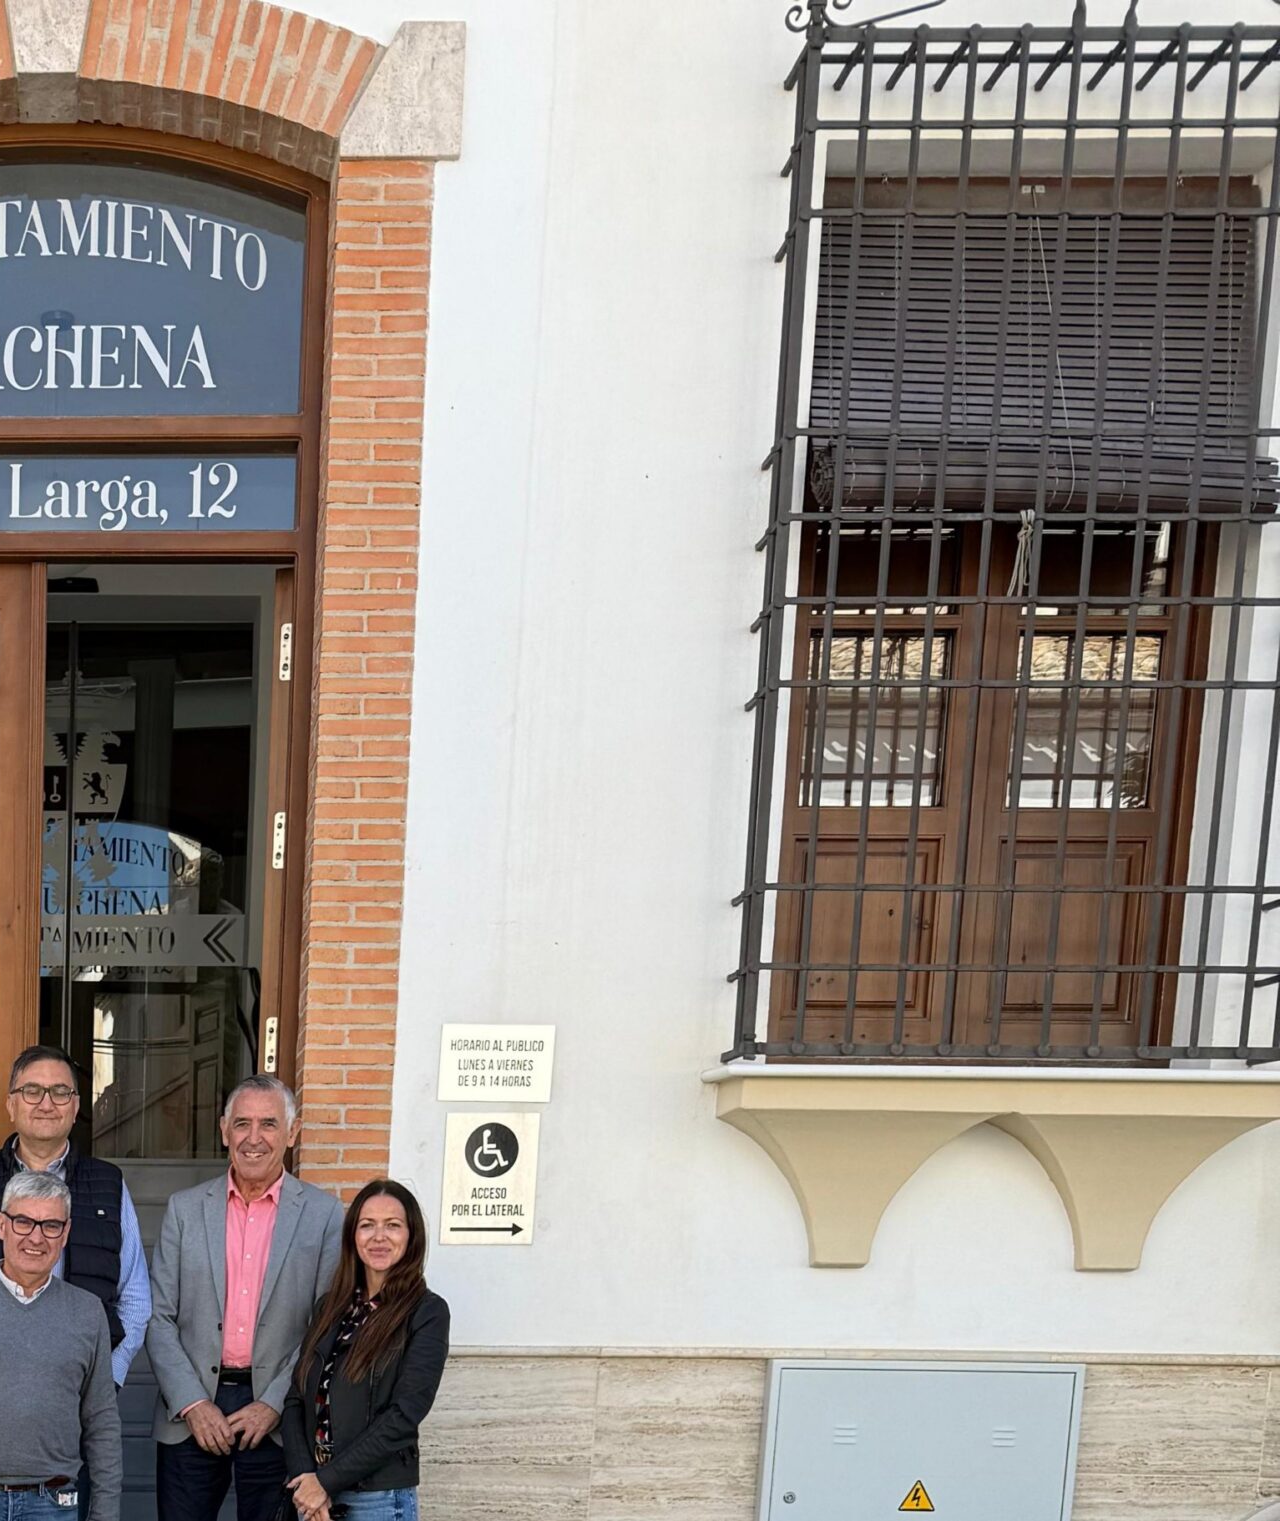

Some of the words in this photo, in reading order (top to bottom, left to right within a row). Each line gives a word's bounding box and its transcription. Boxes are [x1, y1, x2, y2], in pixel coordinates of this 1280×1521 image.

[8, 462, 169, 532] Larga,
[187, 461, 239, 519] 12
[450, 1039, 490, 1052] HORARIO
[492, 1040, 504, 1052] AL
[506, 1040, 544, 1052] PUBLICO
[458, 1059, 486, 1071] LUNES
[488, 1060, 494, 1070] A
[497, 1059, 534, 1071] VIERNES
[458, 1075, 469, 1087] DE
[472, 1076, 478, 1086] 9
[480, 1076, 486, 1086] A
[489, 1075, 500, 1087] 14
[501, 1075, 532, 1087] HORAS
[471, 1187, 507, 1200] ACCESO
[451, 1204, 470, 1216] POR
[472, 1204, 483, 1216] EL
[484, 1204, 525, 1217] LATERAL
